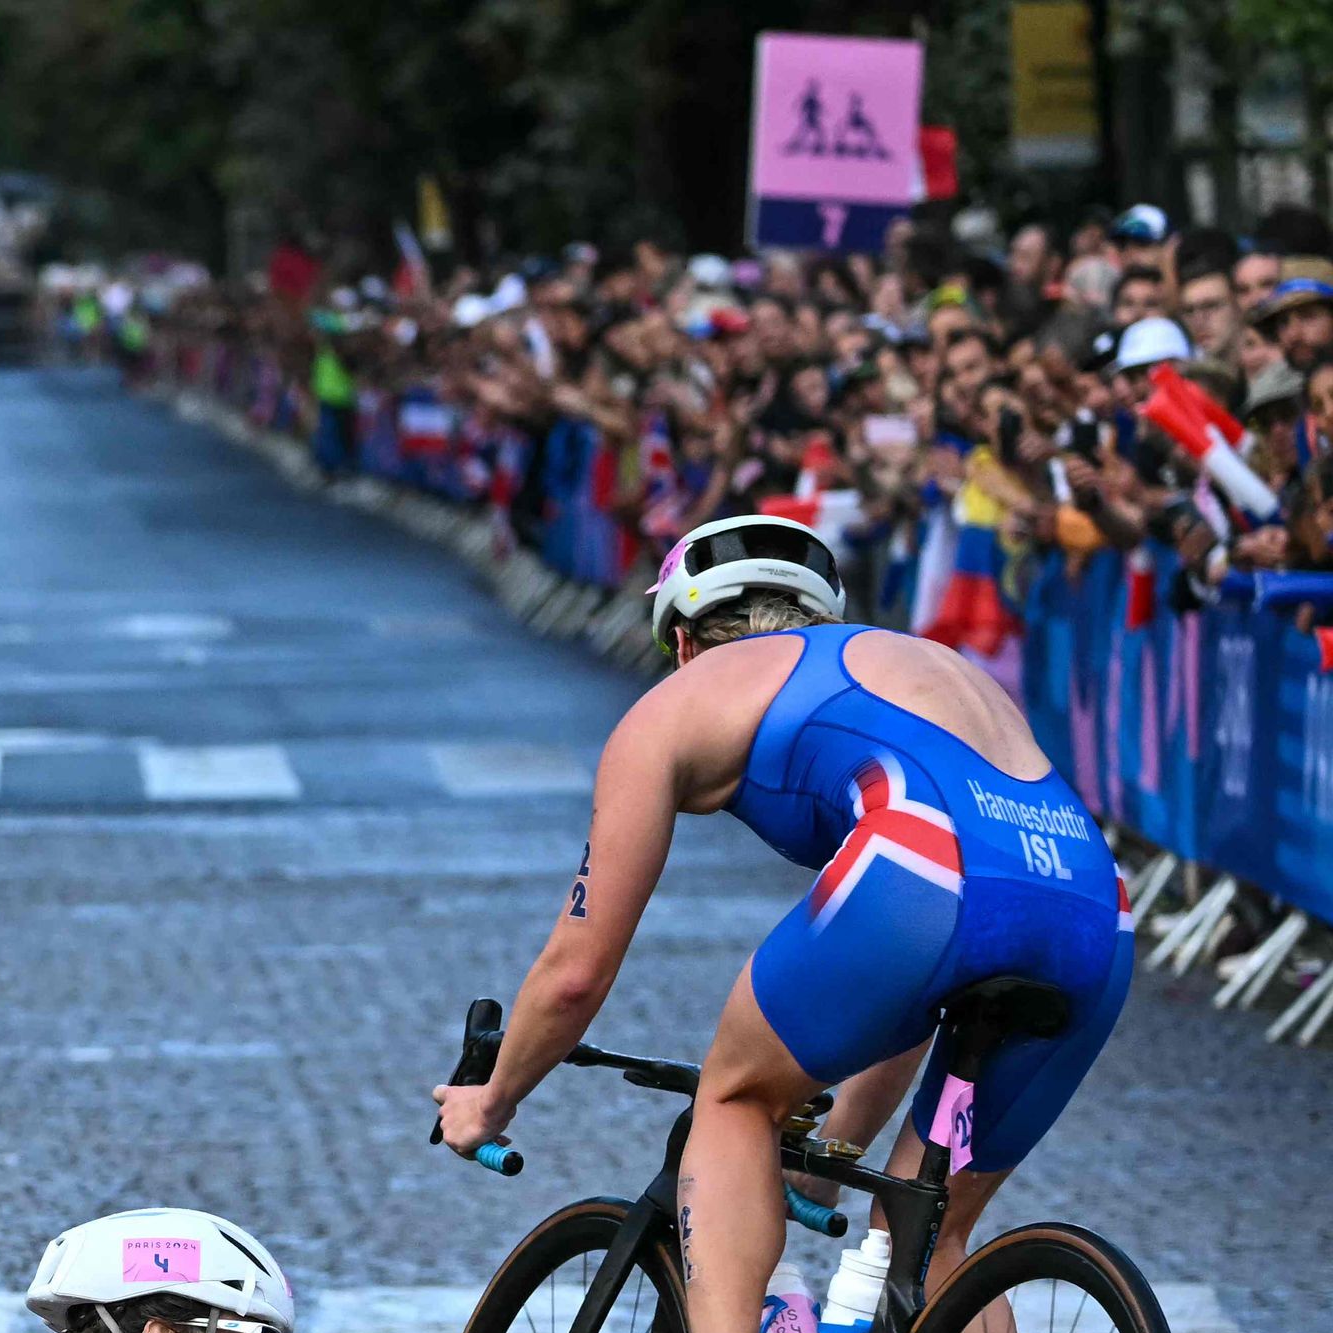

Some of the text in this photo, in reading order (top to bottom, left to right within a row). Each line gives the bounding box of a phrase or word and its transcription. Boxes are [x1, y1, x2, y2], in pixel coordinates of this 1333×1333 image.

[966, 778, 1090, 842] Hannesdottir
[1018, 830, 1073, 881] ISL
[127, 1241, 197, 1250] PARIS 2024
[154, 1253, 169, 1273] 4
